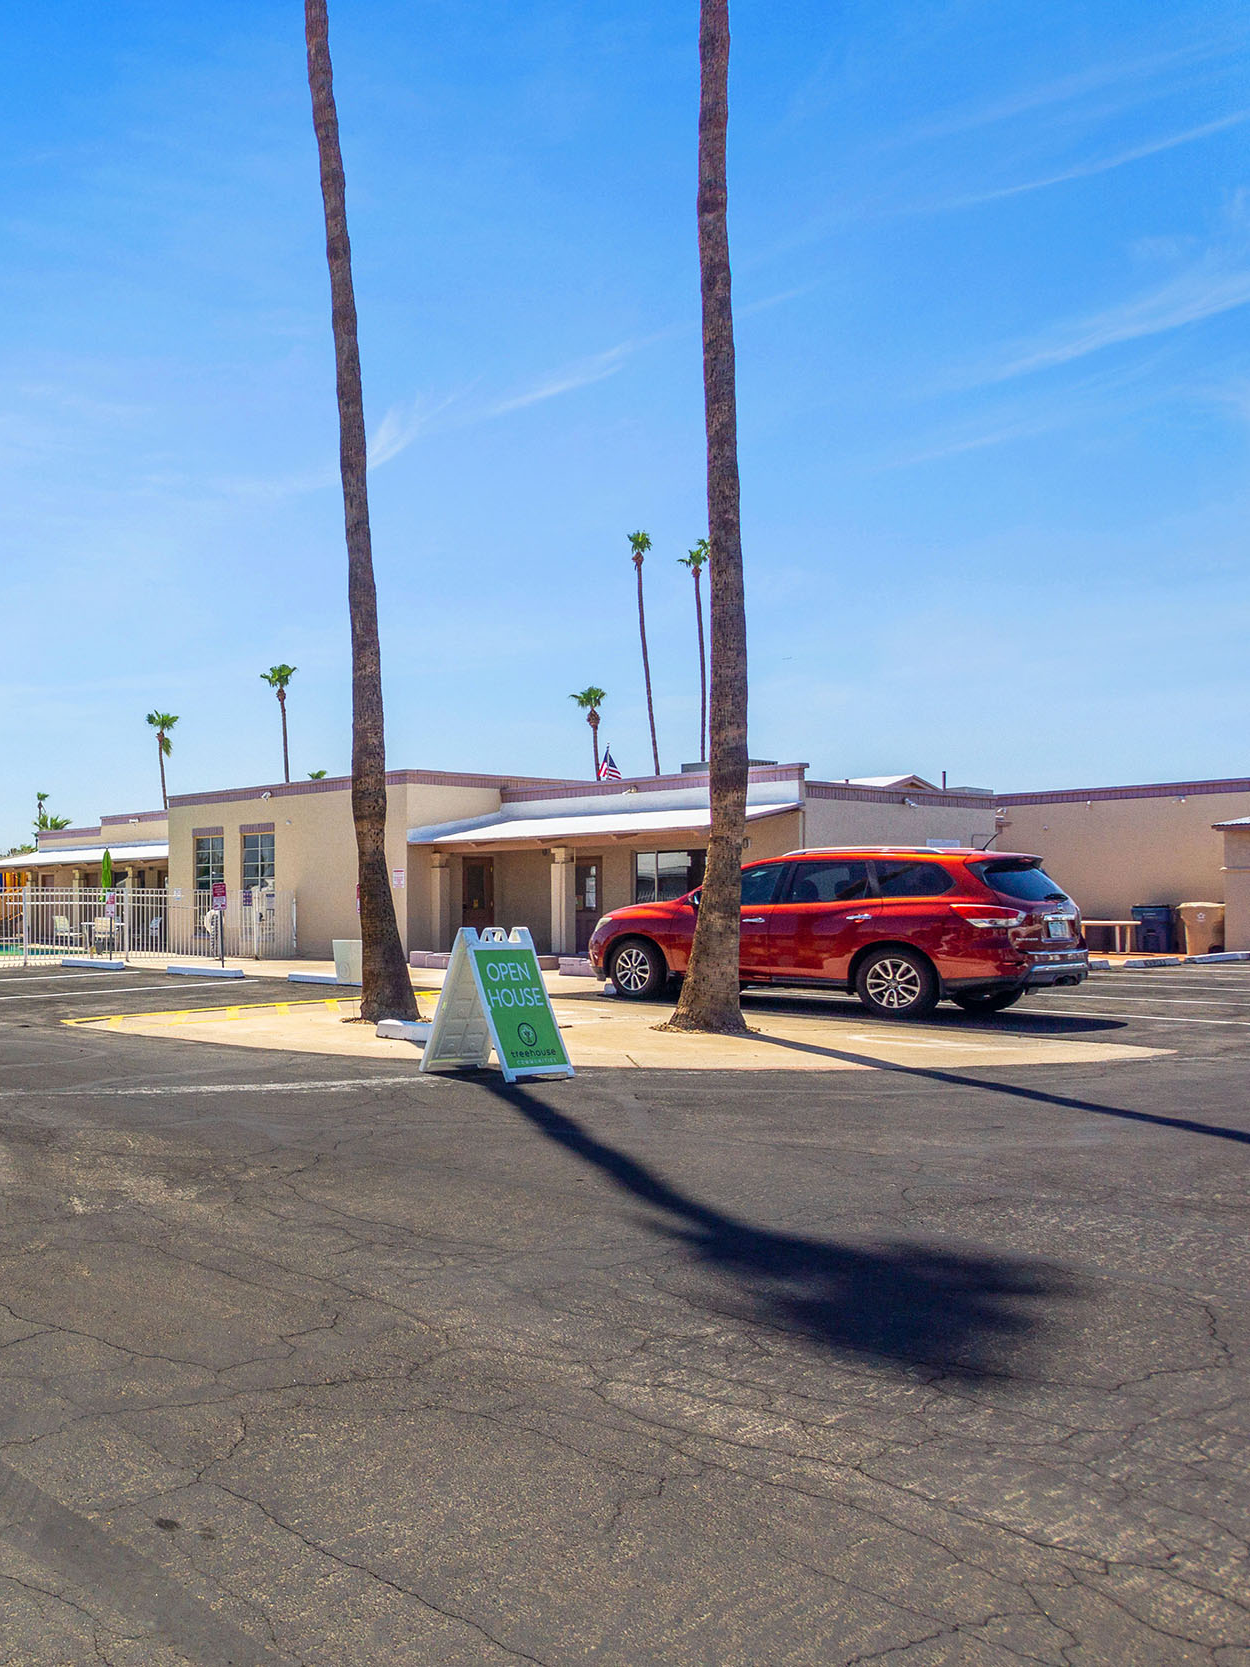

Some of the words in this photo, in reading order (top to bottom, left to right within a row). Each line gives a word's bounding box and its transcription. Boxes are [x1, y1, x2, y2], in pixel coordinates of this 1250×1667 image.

[486, 962, 531, 982] OPEN
[488, 987, 544, 1008] HOUSE
[511, 1049, 556, 1058] treehouse
